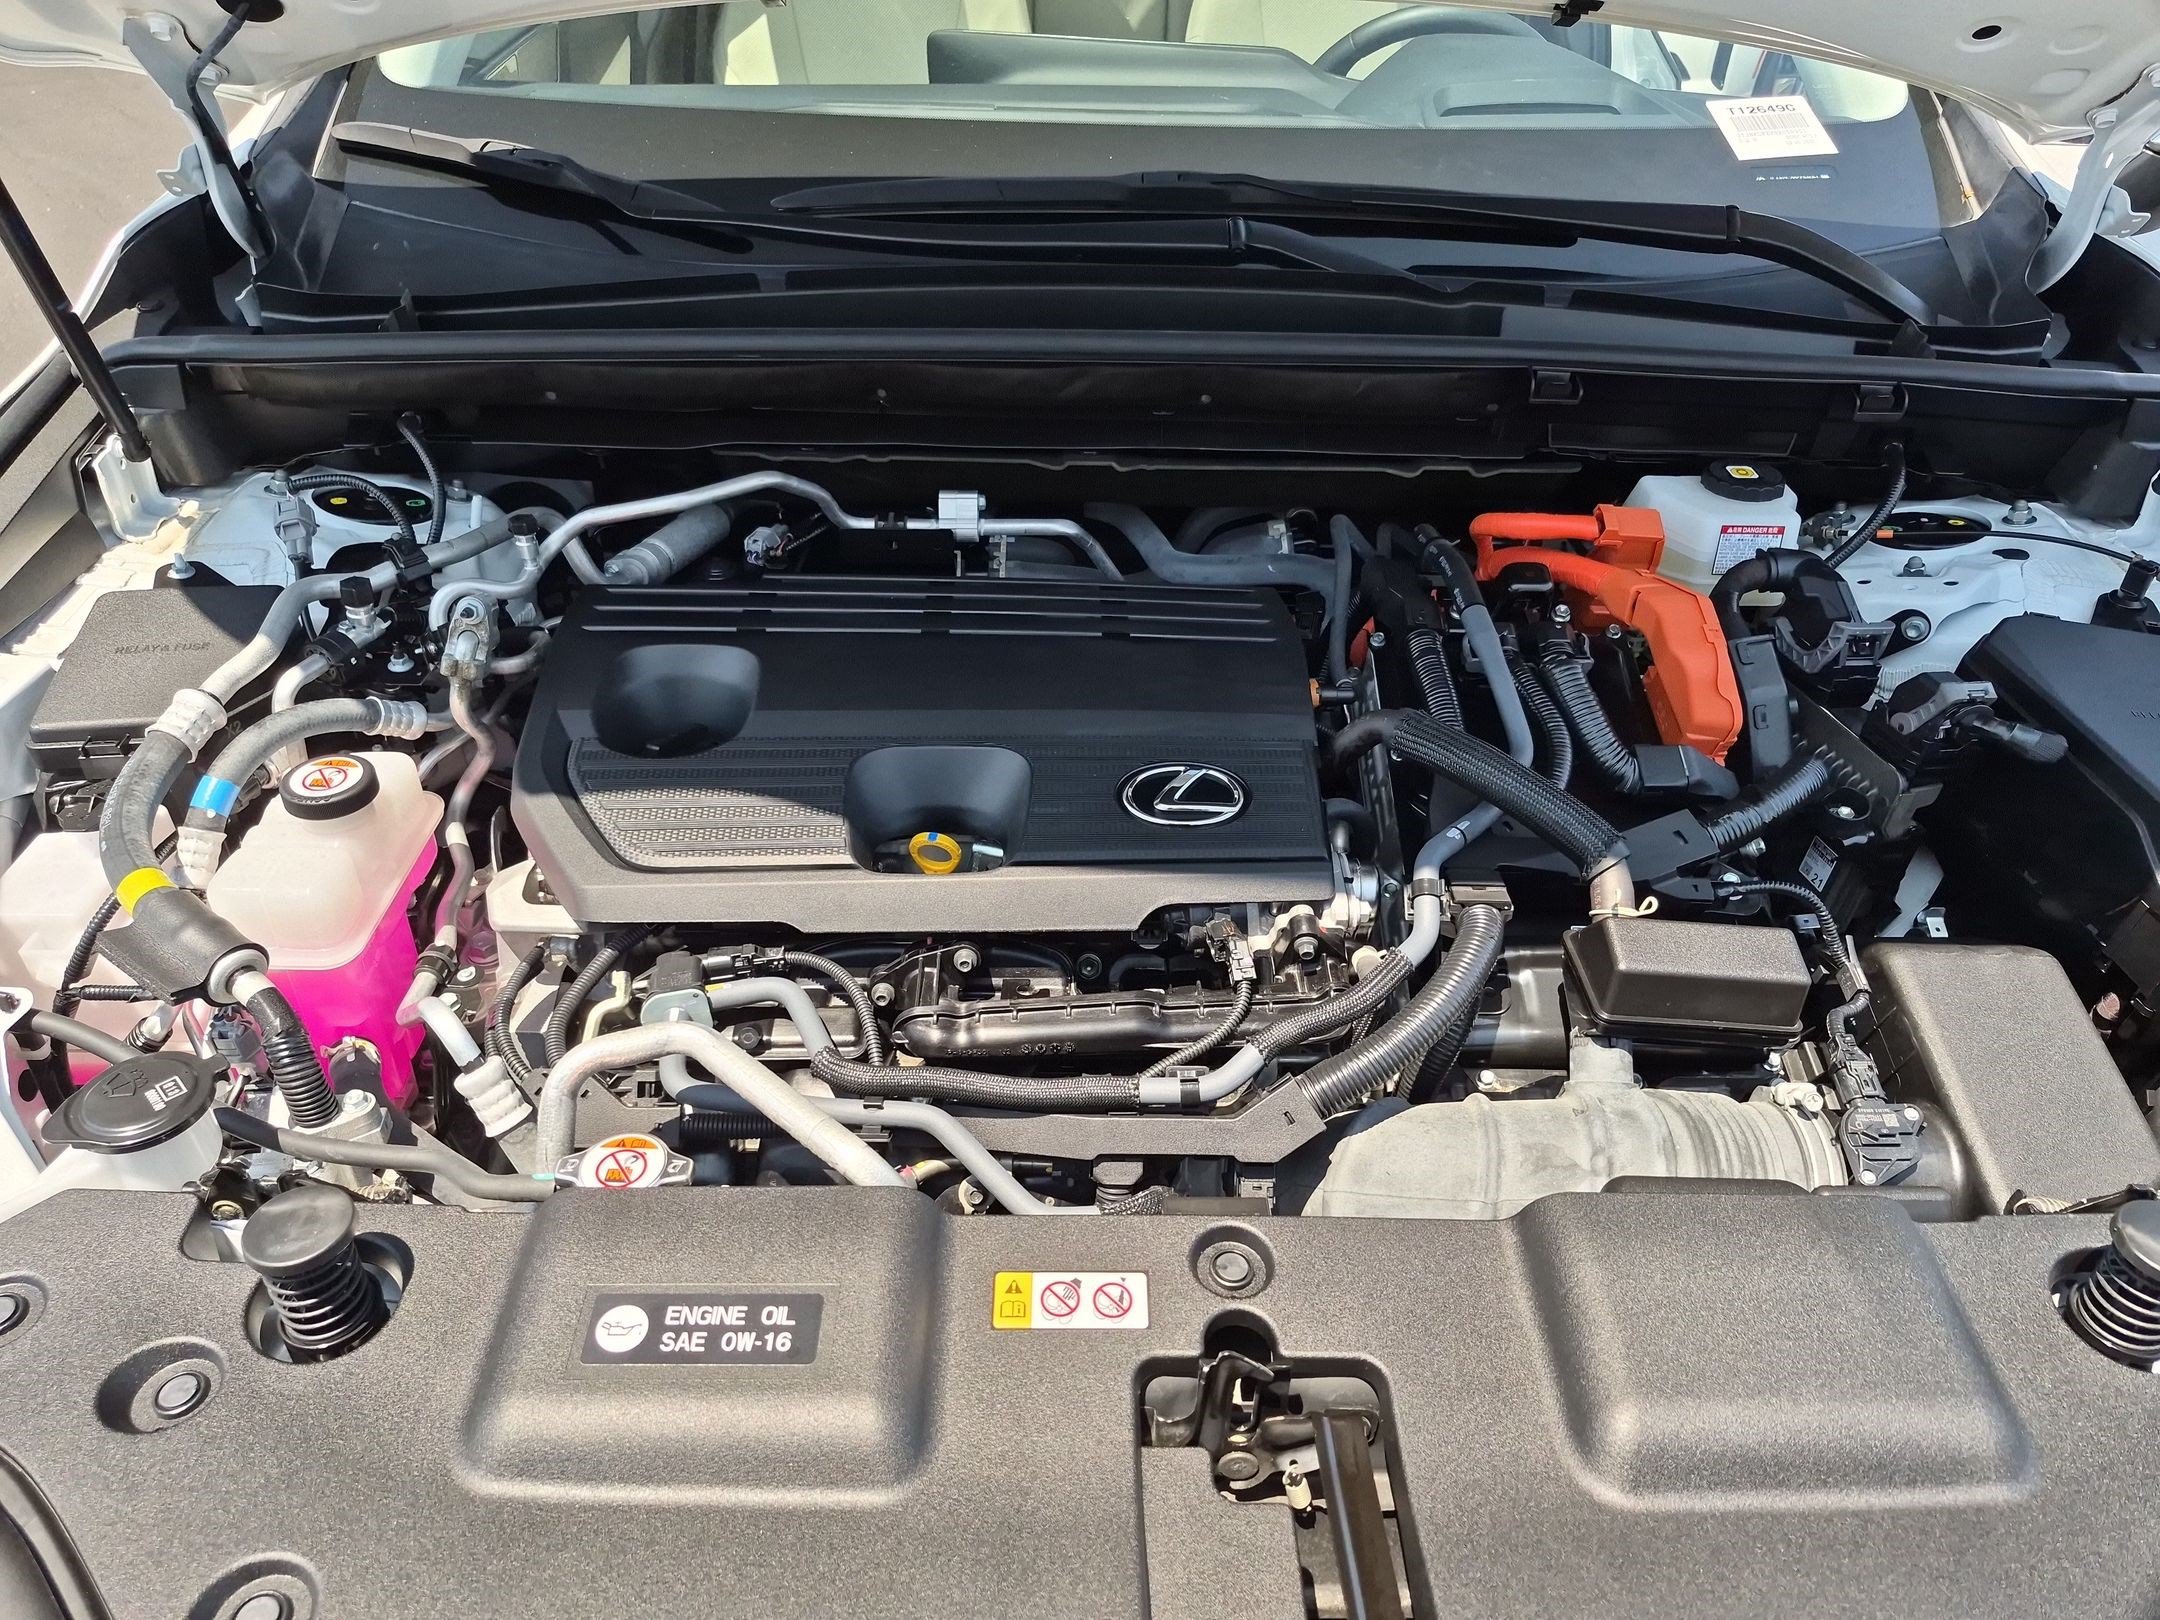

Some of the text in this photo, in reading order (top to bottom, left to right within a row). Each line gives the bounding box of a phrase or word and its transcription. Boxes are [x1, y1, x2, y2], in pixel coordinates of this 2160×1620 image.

[664, 1305, 796, 1326] ENGINE OIL
[659, 1331, 793, 1352] SAE 0W-16
